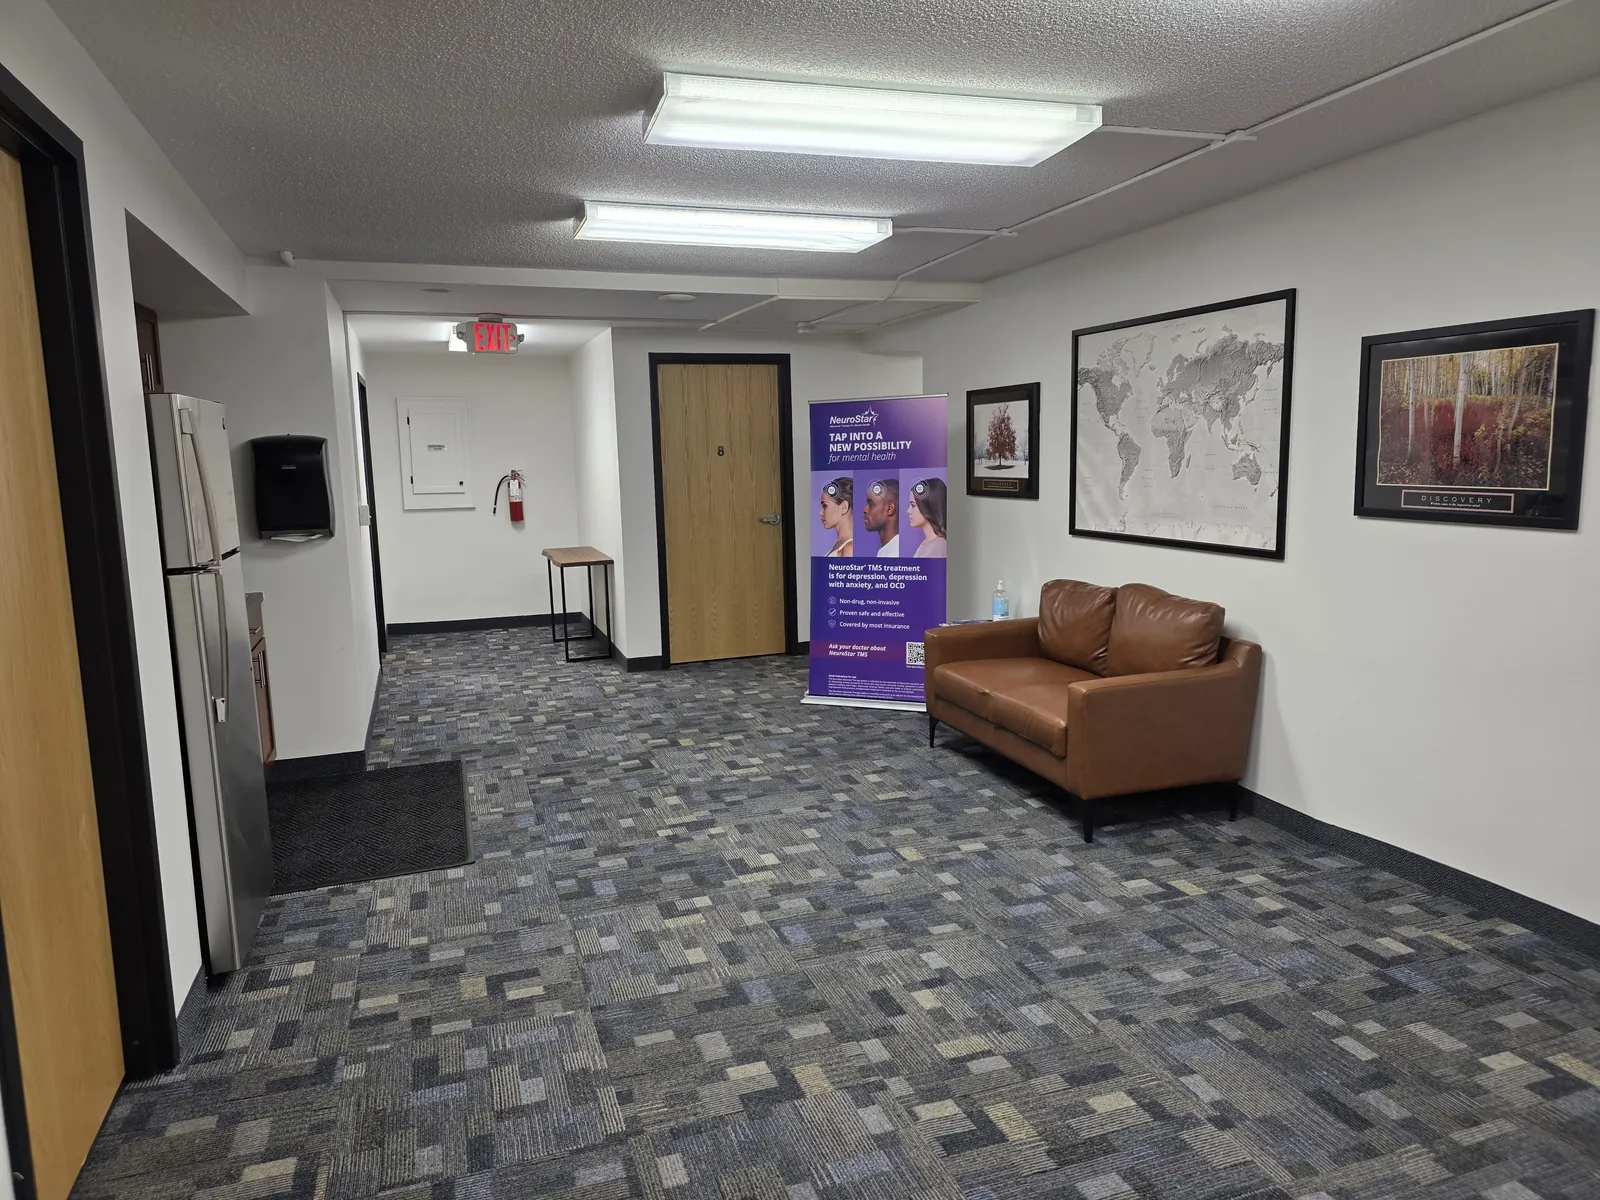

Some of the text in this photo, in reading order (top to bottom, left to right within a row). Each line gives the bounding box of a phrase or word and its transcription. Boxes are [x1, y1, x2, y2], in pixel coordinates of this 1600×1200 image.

[474, 323, 511, 352] EXIT
[829, 414, 873, 425] NeuroStar
[829, 431, 883, 442] TAP INTO A
[829, 440, 912, 452] NEW POSSIBILITY
[827, 451, 896, 465] for mental health
[1421, 495, 1492, 504] DISCOVERY
[868, 564, 882, 572] TMS
[883, 564, 920, 572] treatment
[835, 572, 846, 580] for
[847, 572, 887, 581] depression,
[888, 573, 927, 582] depression
[845, 581, 874, 590] anxiety,
[874, 581, 888, 589] and
[839, 598, 866, 606] Non-drug,
